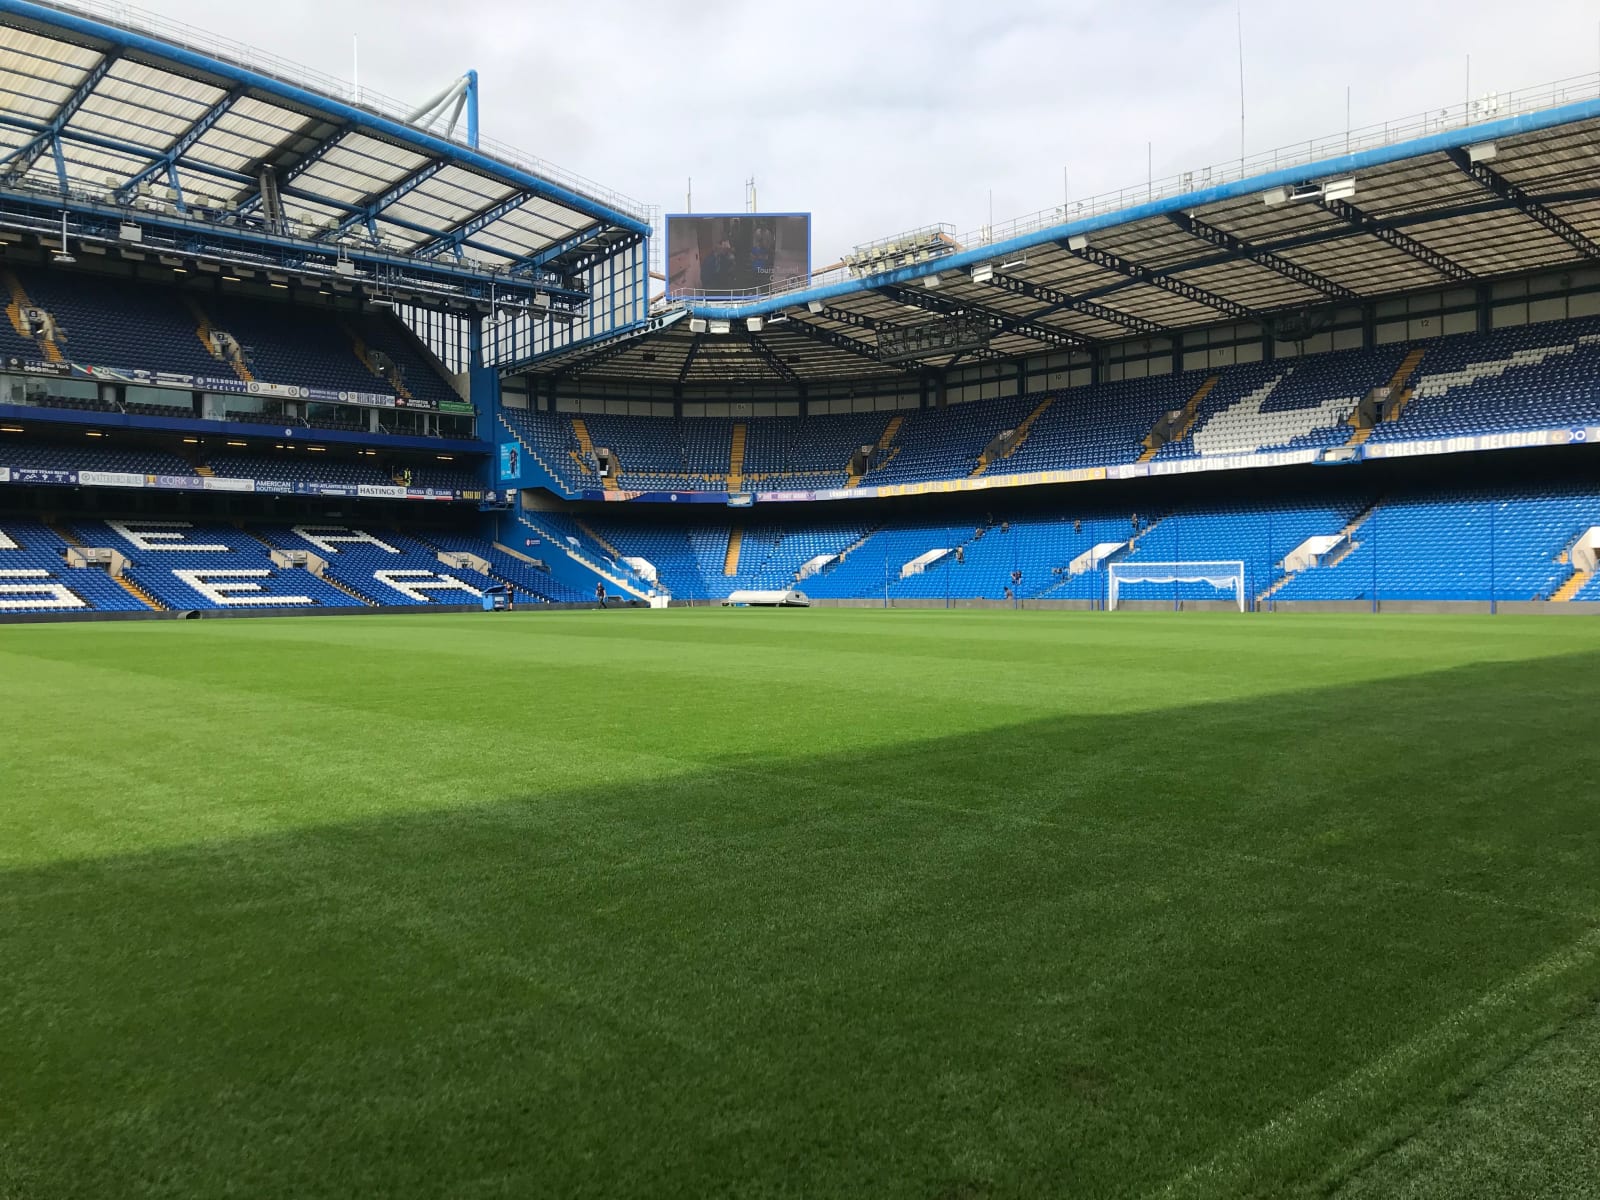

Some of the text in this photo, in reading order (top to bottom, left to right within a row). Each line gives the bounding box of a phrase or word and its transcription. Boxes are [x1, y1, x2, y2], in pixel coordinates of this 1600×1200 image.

[206, 377, 247, 386] MELBOURNE
[206, 384, 247, 393] CHELSEA
[1385, 440, 1442, 457] CHELSEA
[1447, 437, 1475, 453] OUR
[1480, 431, 1548, 449] RELIGION
[160, 476, 187, 486] CORK
[256, 480, 291, 488] AMERICAN
[359, 487, 396, 497] HASTINGS
